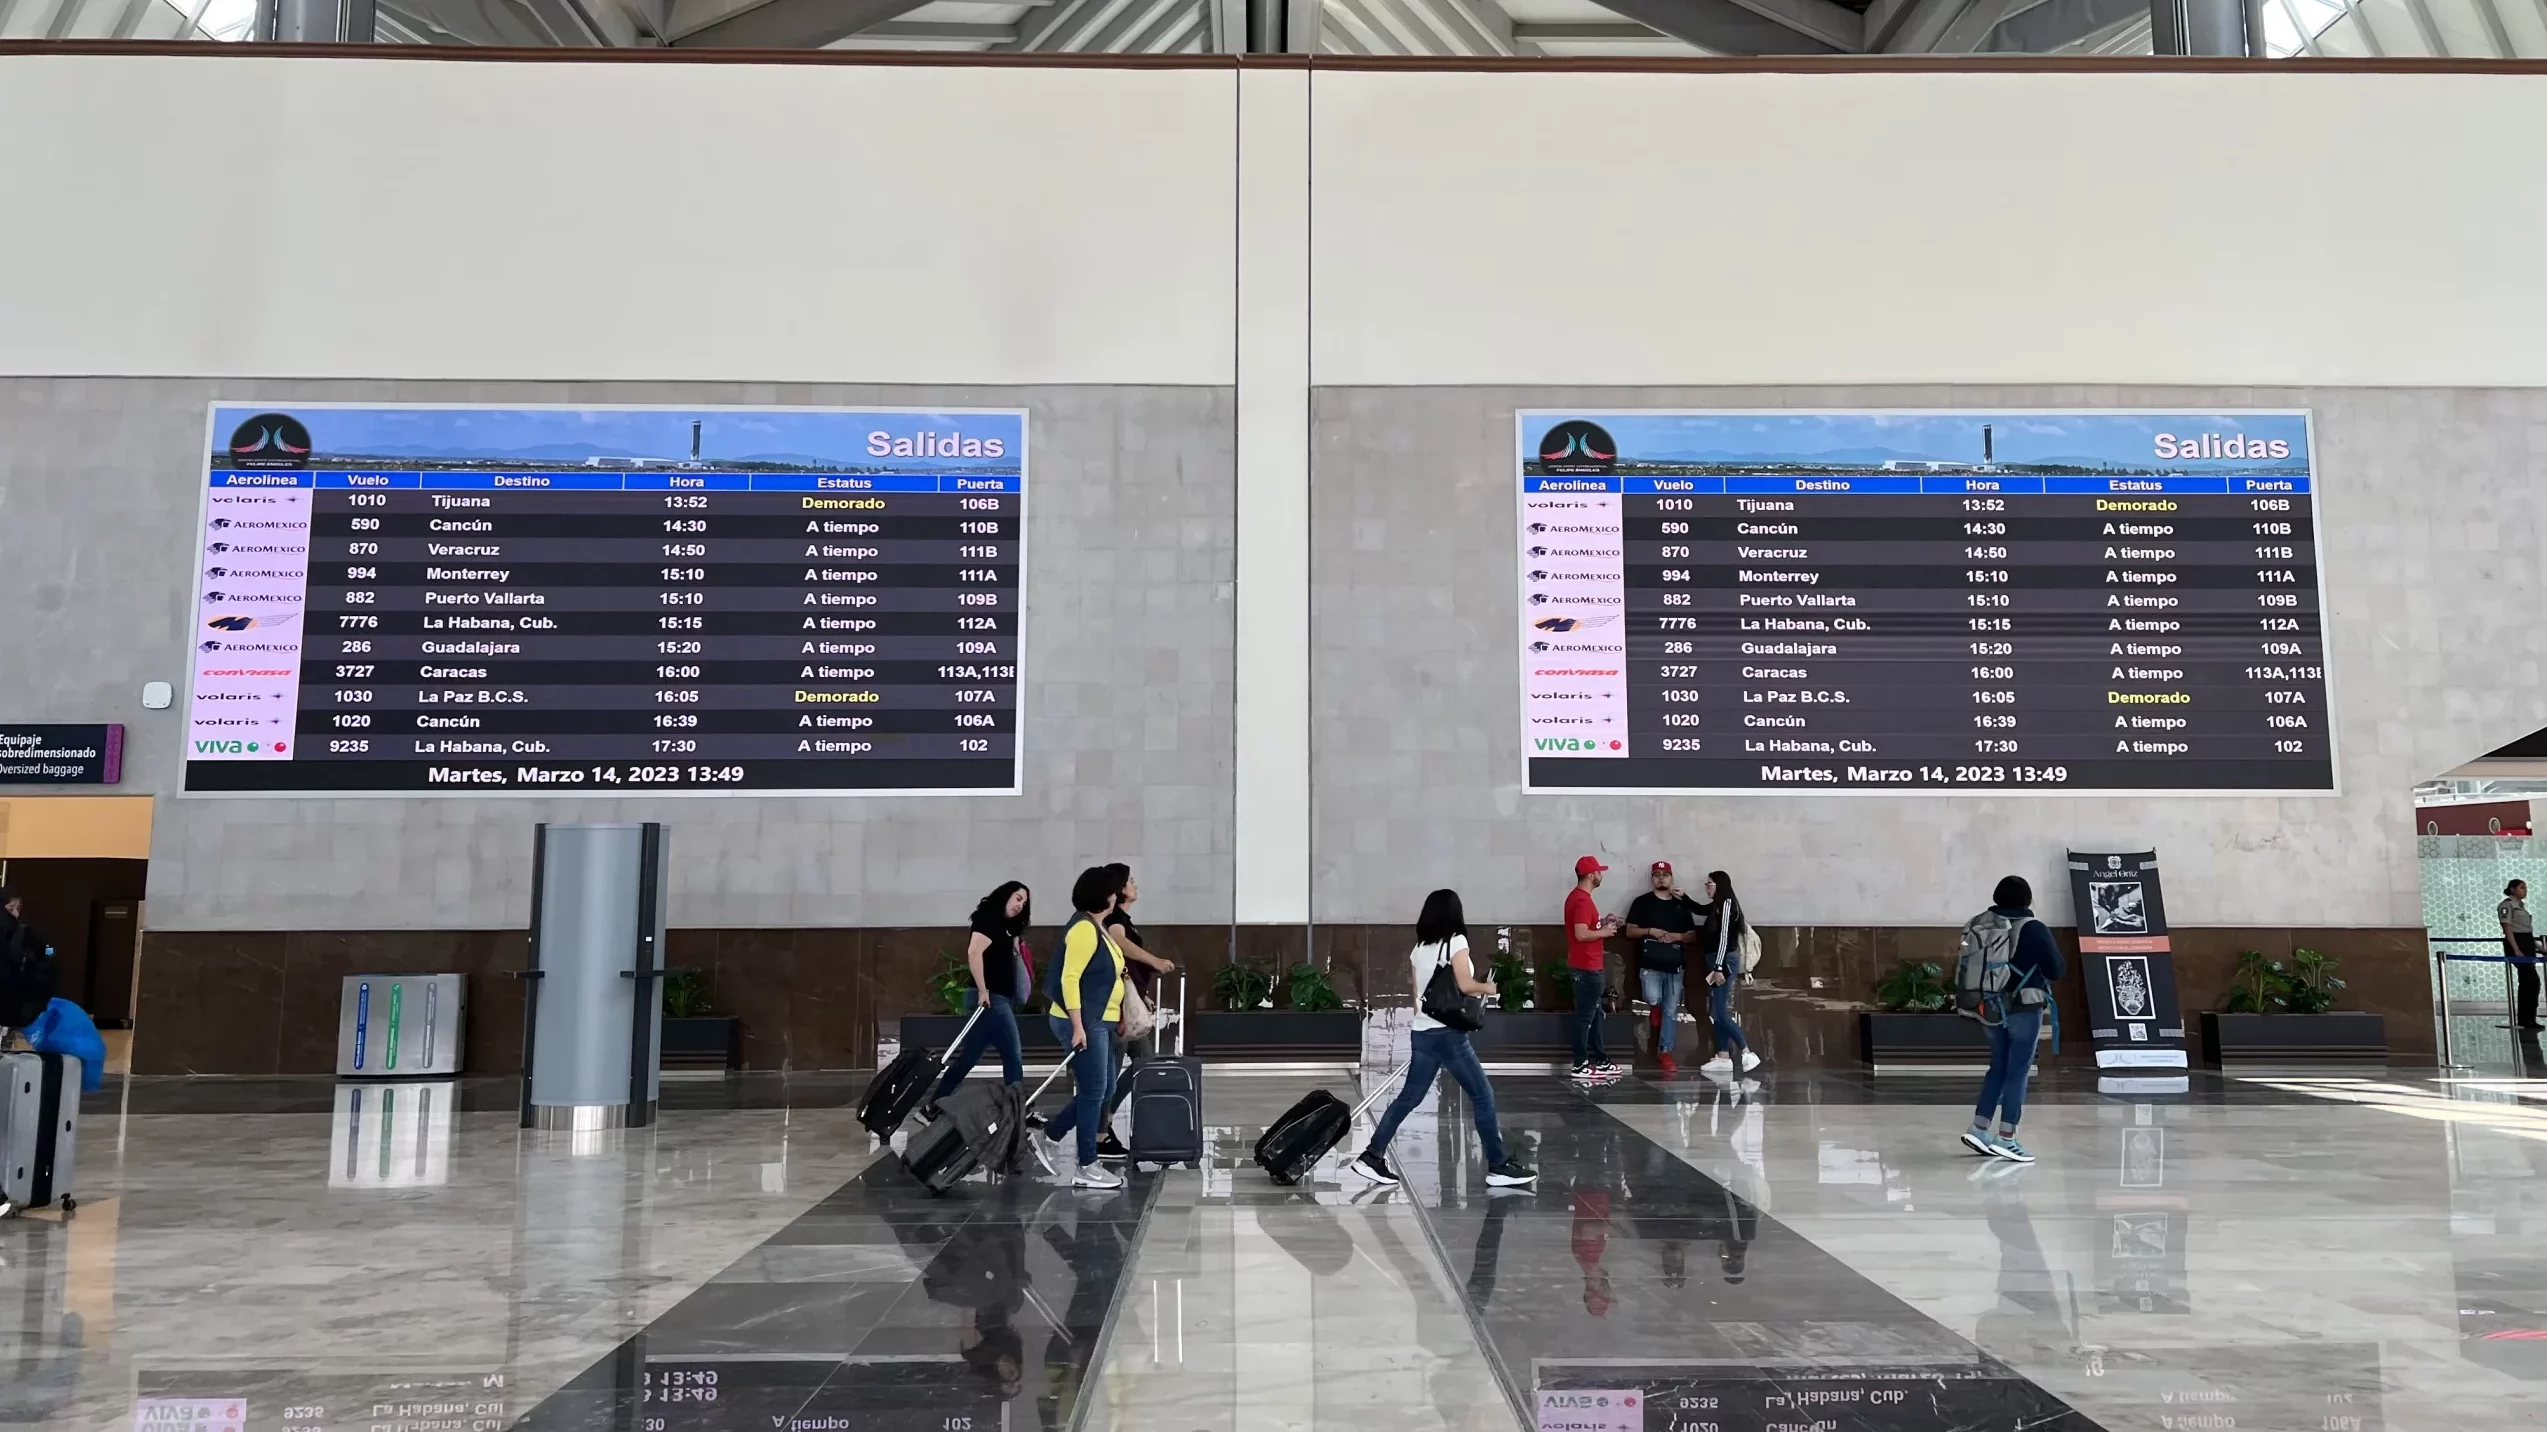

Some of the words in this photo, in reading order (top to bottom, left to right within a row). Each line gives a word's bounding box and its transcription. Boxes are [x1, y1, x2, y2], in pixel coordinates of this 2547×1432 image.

[866, 430, 1005, 458] Salidas
[2153, 432, 2291, 460] Salidas
[226, 474, 298, 486] Aerolínea
[347, 475, 389, 487] Vuelo
[494, 475, 551, 488] Destino
[669, 476, 705, 488] Hora
[817, 477, 872, 489] Estatus
[957, 478, 1004, 491] Puerta
[1539, 479, 1607, 491] Aerolínea
[1653, 479, 1694, 491] Vuelo
[1795, 479, 1850, 491] Destino
[1965, 479, 2000, 491] Hora
[2109, 479, 2163, 491] Estatus
[2245, 479, 2293, 491] Puerta
[348, 494, 387, 507] 1010
[431, 494, 491, 510] Tijuana
[664, 496, 708, 509] 13:52
[802, 496, 886, 510] Demorado
[959, 498, 1000, 511] 106B
[1656, 498, 1693, 511] 1010
[1736, 498, 1795, 514] Tijuana
[1962, 499, 2005, 512] 13:52
[2096, 499, 2178, 512] Demorado
[2250, 499, 2290, 512] 106B
[350, 518, 380, 530] 590
[429, 518, 492, 531] Cancún
[663, 520, 707, 532] 14:30
[806, 520, 820, 533] A
[823, 520, 880, 536] tiempo
[959, 521, 999, 534] 110B
[1661, 522, 1689, 534] 590
[1737, 522, 1798, 535] Cancún
[1963, 522, 2006, 535] 14:30
[2102, 522, 2116, 535] A
[2119, 522, 2174, 538] tiempo
[2252, 522, 2292, 535] 110B
[349, 542, 378, 555] 870
[427, 543, 500, 556] Veracruz
[662, 544, 706, 556] 14:50
[805, 544, 819, 557] A
[822, 544, 879, 560] tiempo
[959, 545, 998, 558] 111B
[1661, 545, 1690, 558] 870
[1737, 546, 1808, 559] Veracruz
[1964, 546, 2007, 559] 14:50
[2104, 546, 2118, 559] A
[2120, 546, 2176, 562] tiempo
[2255, 546, 2293, 559] 111B
[347, 566, 377, 579] 994
[426, 567, 510, 583] Monterrey
[661, 568, 705, 581] 15:10
[804, 568, 818, 581] A
[821, 568, 878, 584] tiempo
[959, 569, 998, 582] 111A
[1662, 569, 1691, 582] 994
[1739, 570, 1820, 585] Monterrey
[1966, 570, 2009, 583] 15:10
[2105, 570, 2119, 583] A
[2121, 570, 2177, 585] tiempo
[2256, 570, 2296, 583] 111A
[345, 591, 375, 604] 882
[425, 591, 480, 605] Puerto
[483, 592, 545, 605] Vallarta
[659, 592, 704, 605] 15:10
[803, 592, 817, 605] A
[820, 592, 877, 608] tiempo
[957, 593, 998, 606] 109B
[339, 615, 378, 628] 7776
[423, 616, 444, 629] La
[448, 616, 515, 631] Habana,
[519, 616, 558, 629] Cub.
[658, 616, 703, 629] 15:15
[802, 616, 816, 629] A
[819, 617, 877, 632] tiempo
[957, 617, 997, 630] 112A
[341, 640, 372, 653] 286
[421, 640, 520, 656] Guadalajara
[657, 641, 701, 654] 15:20
[801, 641, 815, 654] A
[818, 641, 876, 657] tiempo
[956, 641, 997, 654] 109A
[335, 665, 375, 678] 3727
[420, 665, 488, 678] Caracas
[656, 665, 700, 678] 16:00
[800, 665, 815, 678] A
[817, 665, 875, 681] tiempo
[334, 690, 373, 703] 1030
[418, 690, 439, 703] La
[443, 690, 474, 703] Paz
[477, 690, 529, 703] B.C.S.
[654, 690, 699, 703] 16:05
[794, 690, 880, 703] Demorado
[954, 690, 996, 703] 107A
[194, 717, 259, 725] volaris
[332, 714, 371, 727] 1020
[416, 714, 480, 728] Cancún
[653, 714, 698, 728] 16:39
[798, 714, 813, 727] A
[816, 714, 873, 730] tiempo
[954, 714, 995, 727] 106A
[0, 734, 42, 748] Equipaje
[329, 739, 369, 753] 9235
[414, 740, 435, 753] La
[440, 740, 507, 755] Habana,
[511, 740, 550, 753] Cub.
[652, 739, 696, 753] 17:30
[797, 739, 811, 752] A
[814, 739, 872, 755] tiempo
[959, 739, 988, 752] 102
[0, 746, 96, 758] obredimensionado
[43, 762, 84, 777] baggage
[428, 767, 508, 785] Martes,
[517, 767, 585, 783] Marzo
[591, 766, 622, 784] 14,
[628, 766, 680, 782] 2023
[687, 766, 744, 782] 13:49
[1761, 765, 1839, 783] Martes,
[1847, 766, 1913, 782] Marzo
[1919, 766, 1950, 784] 14,
[1955, 766, 2005, 782] 2023
[2012, 766, 2068, 782] 13:49
